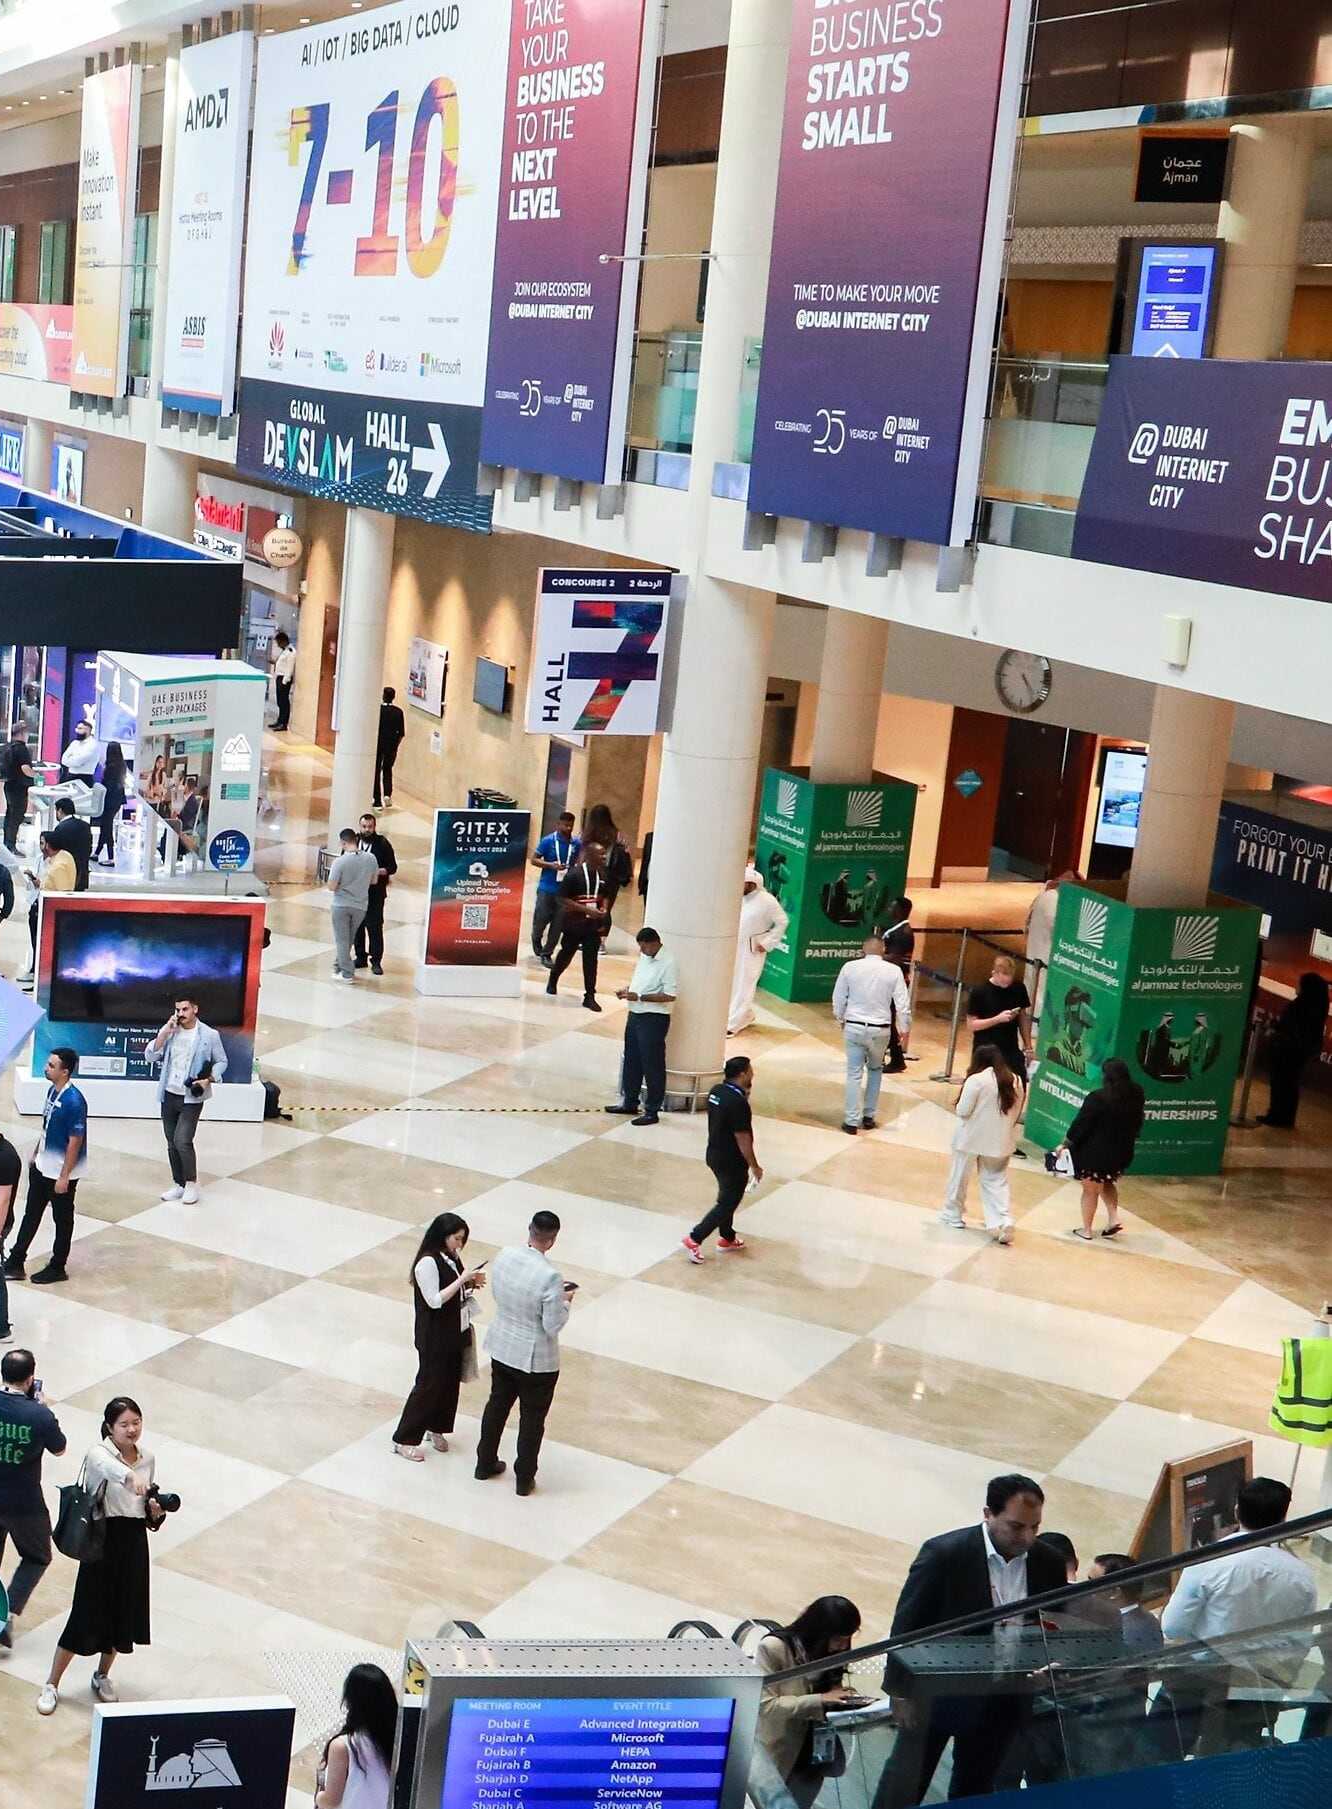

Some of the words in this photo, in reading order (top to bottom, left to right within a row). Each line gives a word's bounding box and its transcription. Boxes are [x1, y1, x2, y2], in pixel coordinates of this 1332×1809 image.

[524, 0, 565, 30] TAKE
[351, 29, 369, 56] BIG
[373, 20, 402, 51] DATA
[416, 5, 460, 39] CLOUD
[809, 0, 943, 56] BUSINESS
[521, 30, 569, 68] YOUR
[516, 62, 605, 108] BUSINESS
[806, 51, 910, 104] STARTS
[516, 112, 537, 144] TO
[541, 106, 575, 141] THE
[802, 104, 892, 151] SMALL
[83, 149, 99, 166] Make
[511, 148, 557, 183] NEXT
[1163, 156, 1202, 170] عجمان
[287, 76, 459, 279] 7-10
[1163, 172, 1199, 185] Ajman
[509, 186, 561, 221] LEVEL
[549, 283, 591, 297] ECOSYSTEM
[793, 284, 818, 301] TIME
[820, 285, 834, 301] TO
[836, 285, 867, 302] MAKE
[870, 285, 901, 303] YOUR
[904, 286, 941, 304] MOVE
[539, 304, 574, 320] INTERNET
[796, 310, 841, 330] @DUBAI
[843, 311, 900, 331] INTERNET
[901, 314, 930, 332] CITY
[183, 316, 206, 337] ASBIS
[290, 400, 326, 425] GLOBAL
[365, 411, 410, 452] HALL
[898, 417, 919, 431] DUBAI
[896, 434, 930, 449] INTERNET
[1162, 424, 1208, 450] DUBAI
[263, 420, 354, 485] DEVSLAM
[894, 450, 911, 464] CITY
[386, 457, 408, 496] 26
[1156, 455, 1229, 484] INTERNET
[1149, 484, 1184, 509] CITY
[551, 579, 606, 587] CONCOURSE
[567, 600, 664, 730] 7
[152, 694, 166, 704] UAE
[170, 690, 207, 703] BUSINESS
[542, 653, 566, 722] HALL
[152, 703, 174, 716] SET-UP
[175, 702, 207, 714] PACKAGES
[453, 821, 509, 837] GITEX
[1233, 820, 1287, 848] FORGOT
[1288, 836, 1324, 859] YOUR
[1236, 839, 1288, 875] PRINT
[1182, 980, 1243, 991] technologies
[488, 1719, 522, 1729] Dubai
[580, 1719, 635, 1729] Advanced
[637, 1719, 699, 1731] Integration
[479, 1733, 523, 1745] Fujairah
[611, 1733, 664, 1743] Microsoft
[484, 1747, 517, 1757] Dubai
[620, 1747, 650, 1757] HEPA
[476, 1759, 521, 1771] Fujairah
[611, 1760, 656, 1770] Amazon
[610, 1773, 653, 1785] NetApp
[478, 1788, 512, 1798] Dubai
[597, 1788, 663, 1798] ServiceNow
